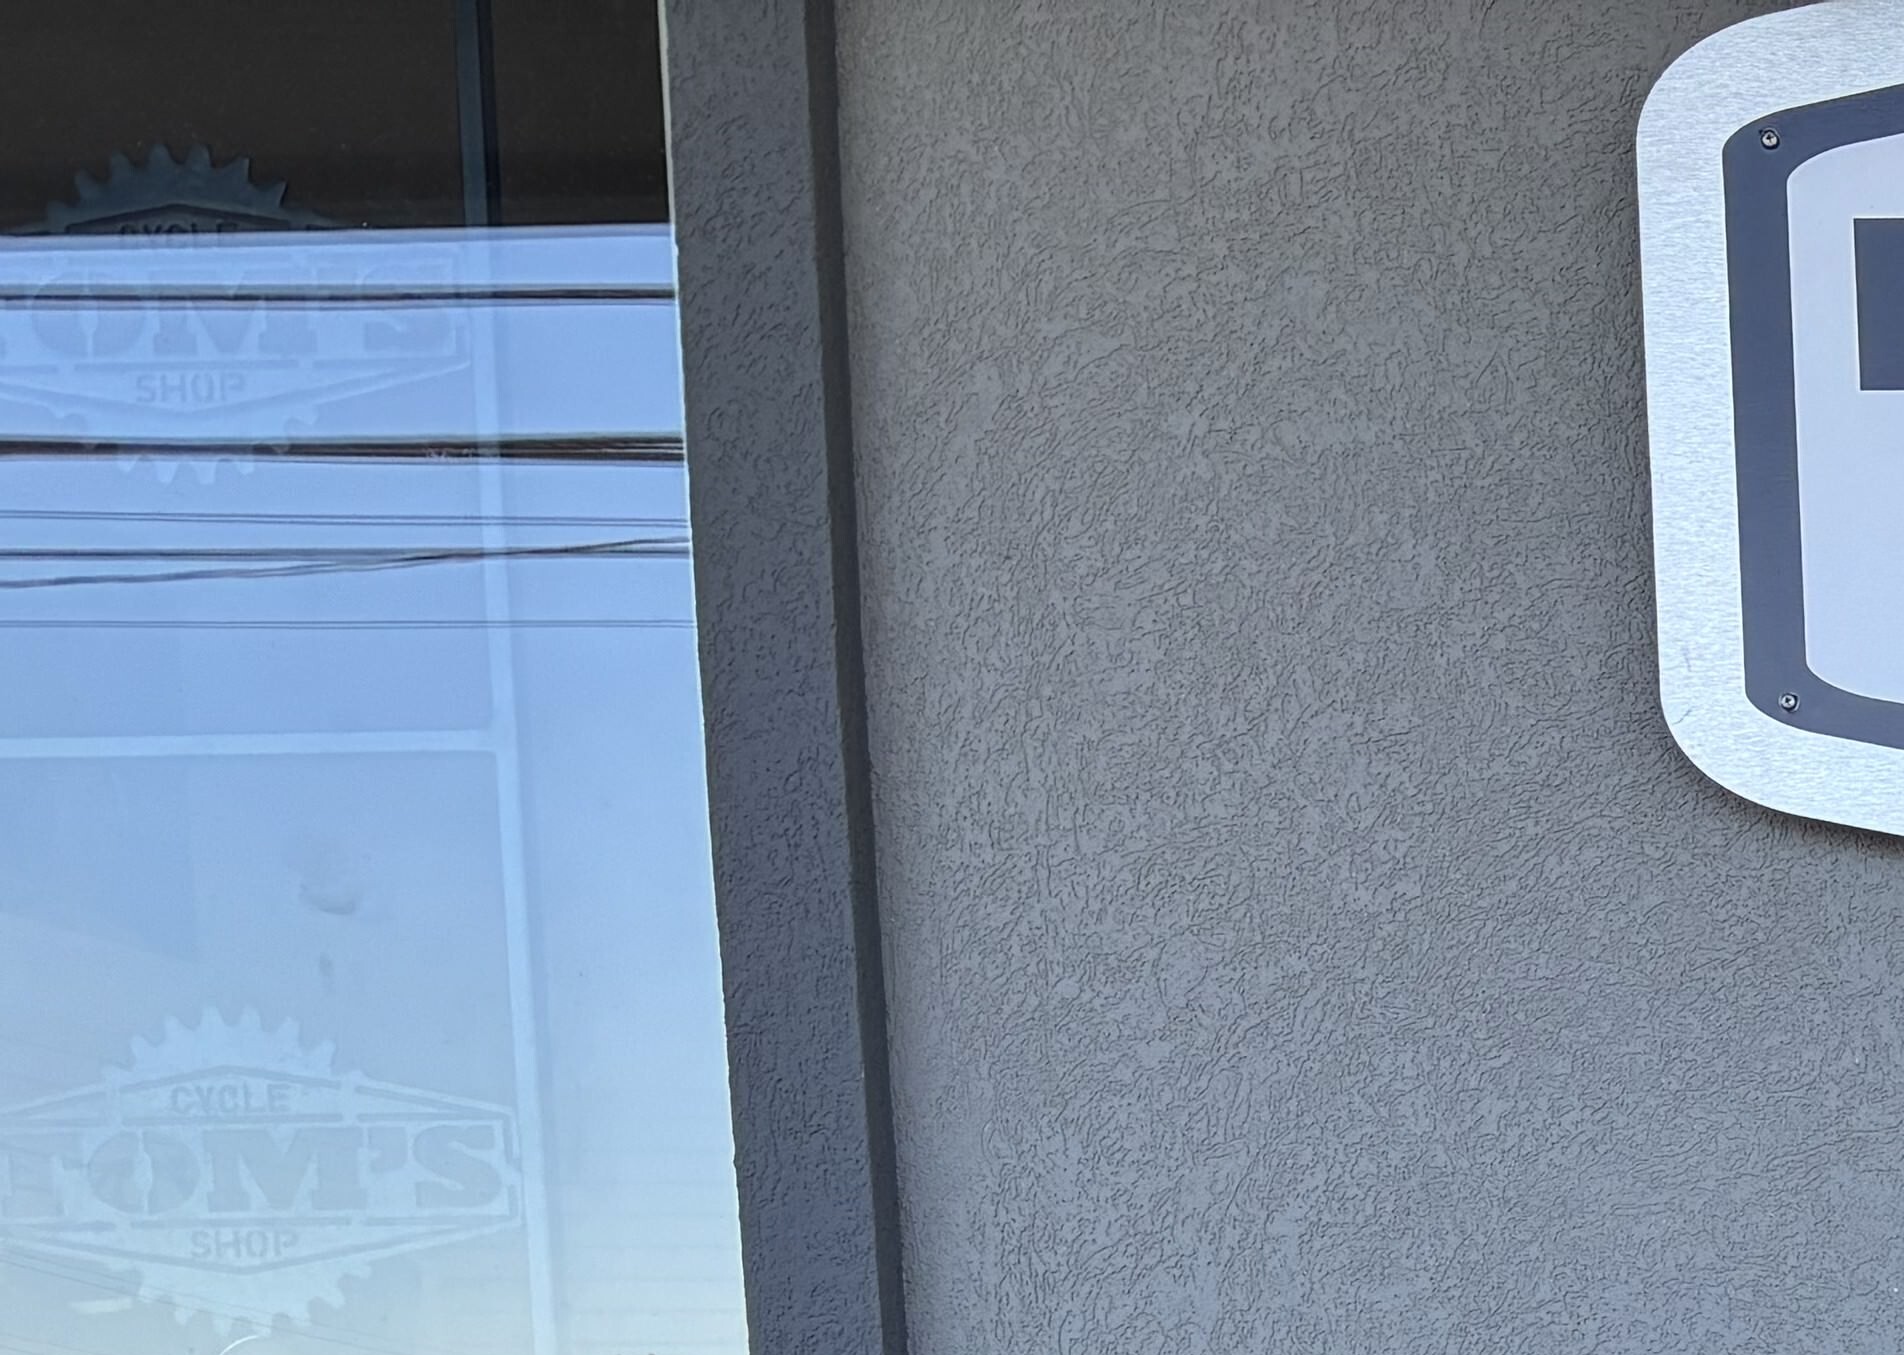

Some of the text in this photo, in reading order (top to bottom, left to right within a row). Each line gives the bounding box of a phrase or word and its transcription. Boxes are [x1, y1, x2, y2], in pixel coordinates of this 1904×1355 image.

[135, 374, 247, 403] SHOP
[169, 1082, 293, 1115] CYCLE
[190, 1229, 298, 1260] SHOP
